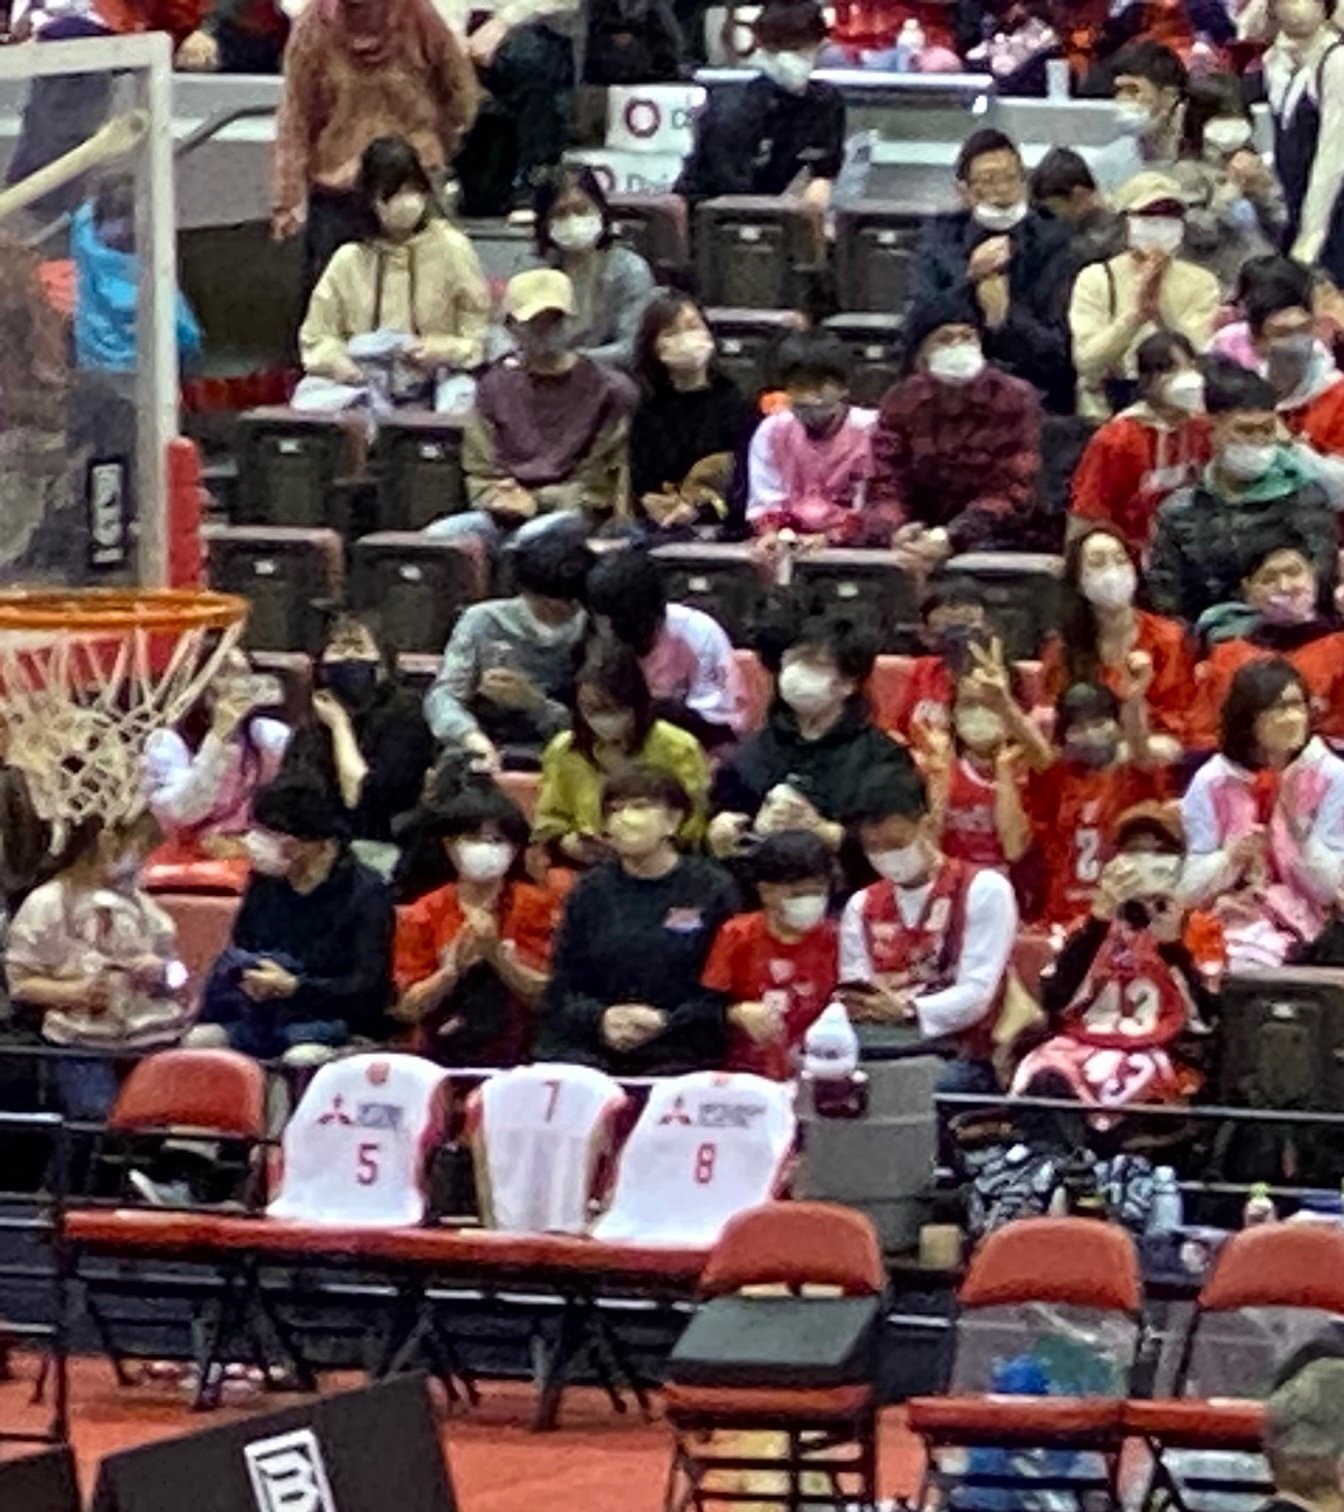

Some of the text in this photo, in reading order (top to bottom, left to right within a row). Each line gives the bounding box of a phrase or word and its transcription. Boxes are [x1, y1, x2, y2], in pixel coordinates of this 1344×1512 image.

[543, 1079, 561, 1122] 7
[356, 1143, 379, 1186] 5
[696, 1142, 716, 1184] 8
